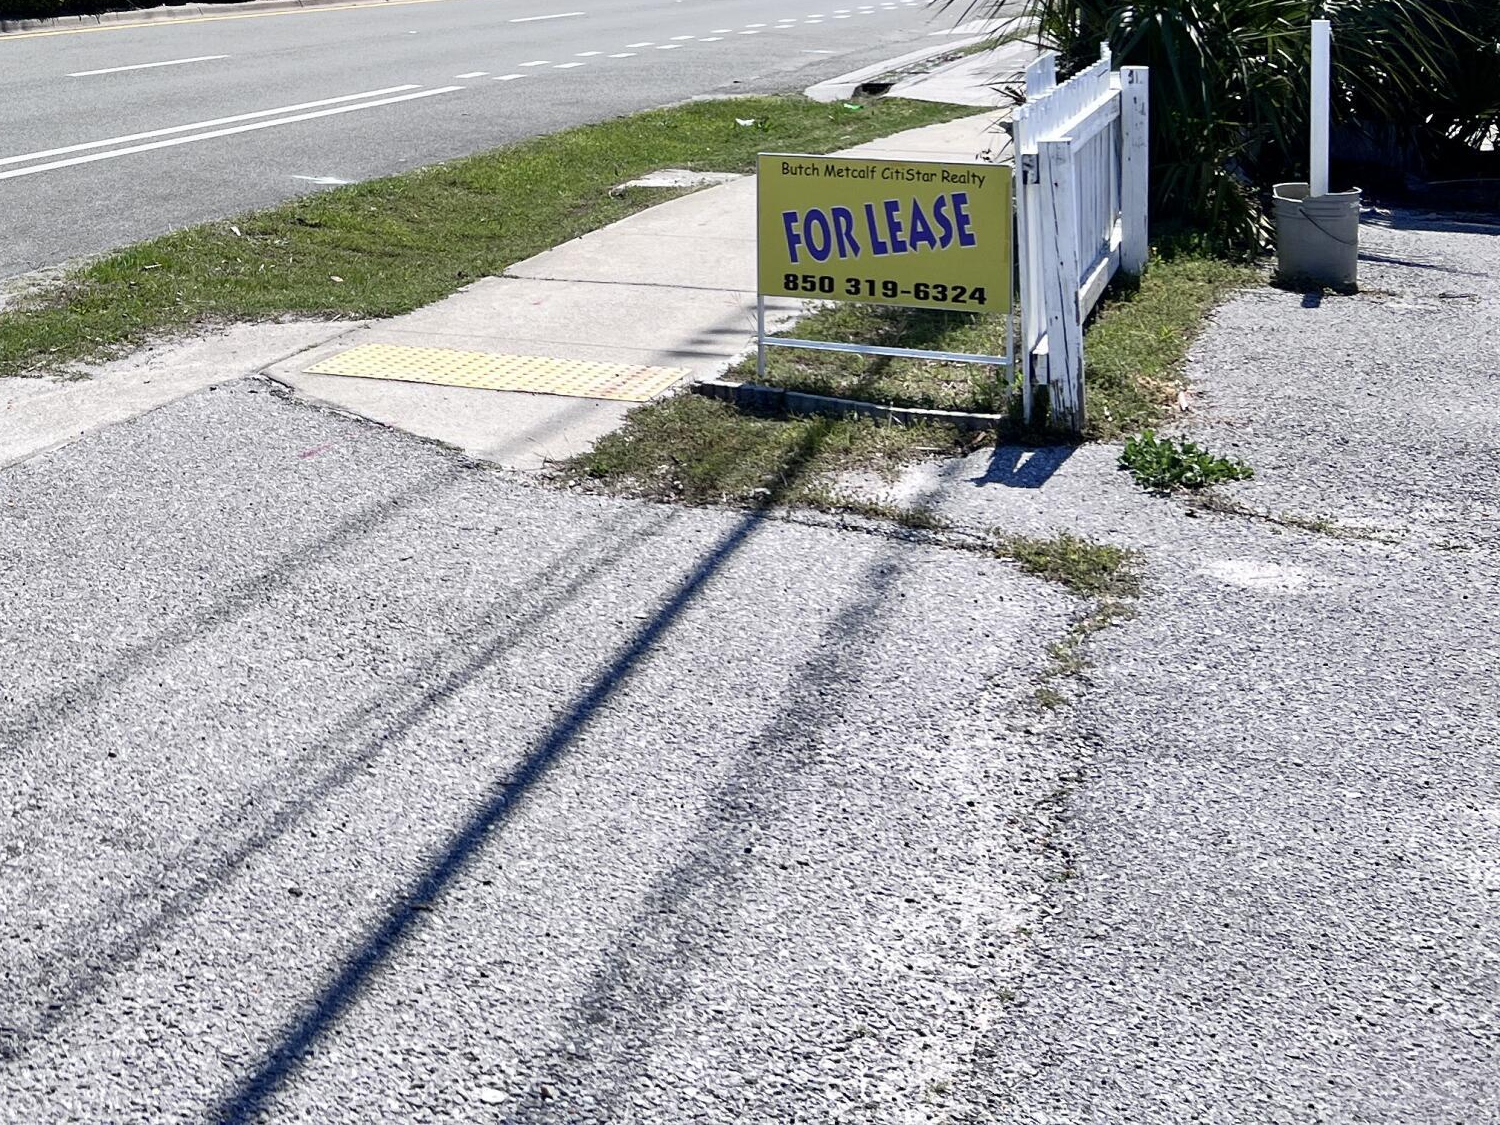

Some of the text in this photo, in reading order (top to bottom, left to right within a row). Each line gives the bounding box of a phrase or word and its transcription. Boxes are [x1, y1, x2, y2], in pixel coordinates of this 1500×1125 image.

[782, 161, 986, 188] Butch Metcalf CitiStar Realty
[781, 191, 976, 264] FOR LEASE
[783, 273, 987, 305] 850 319-6324
